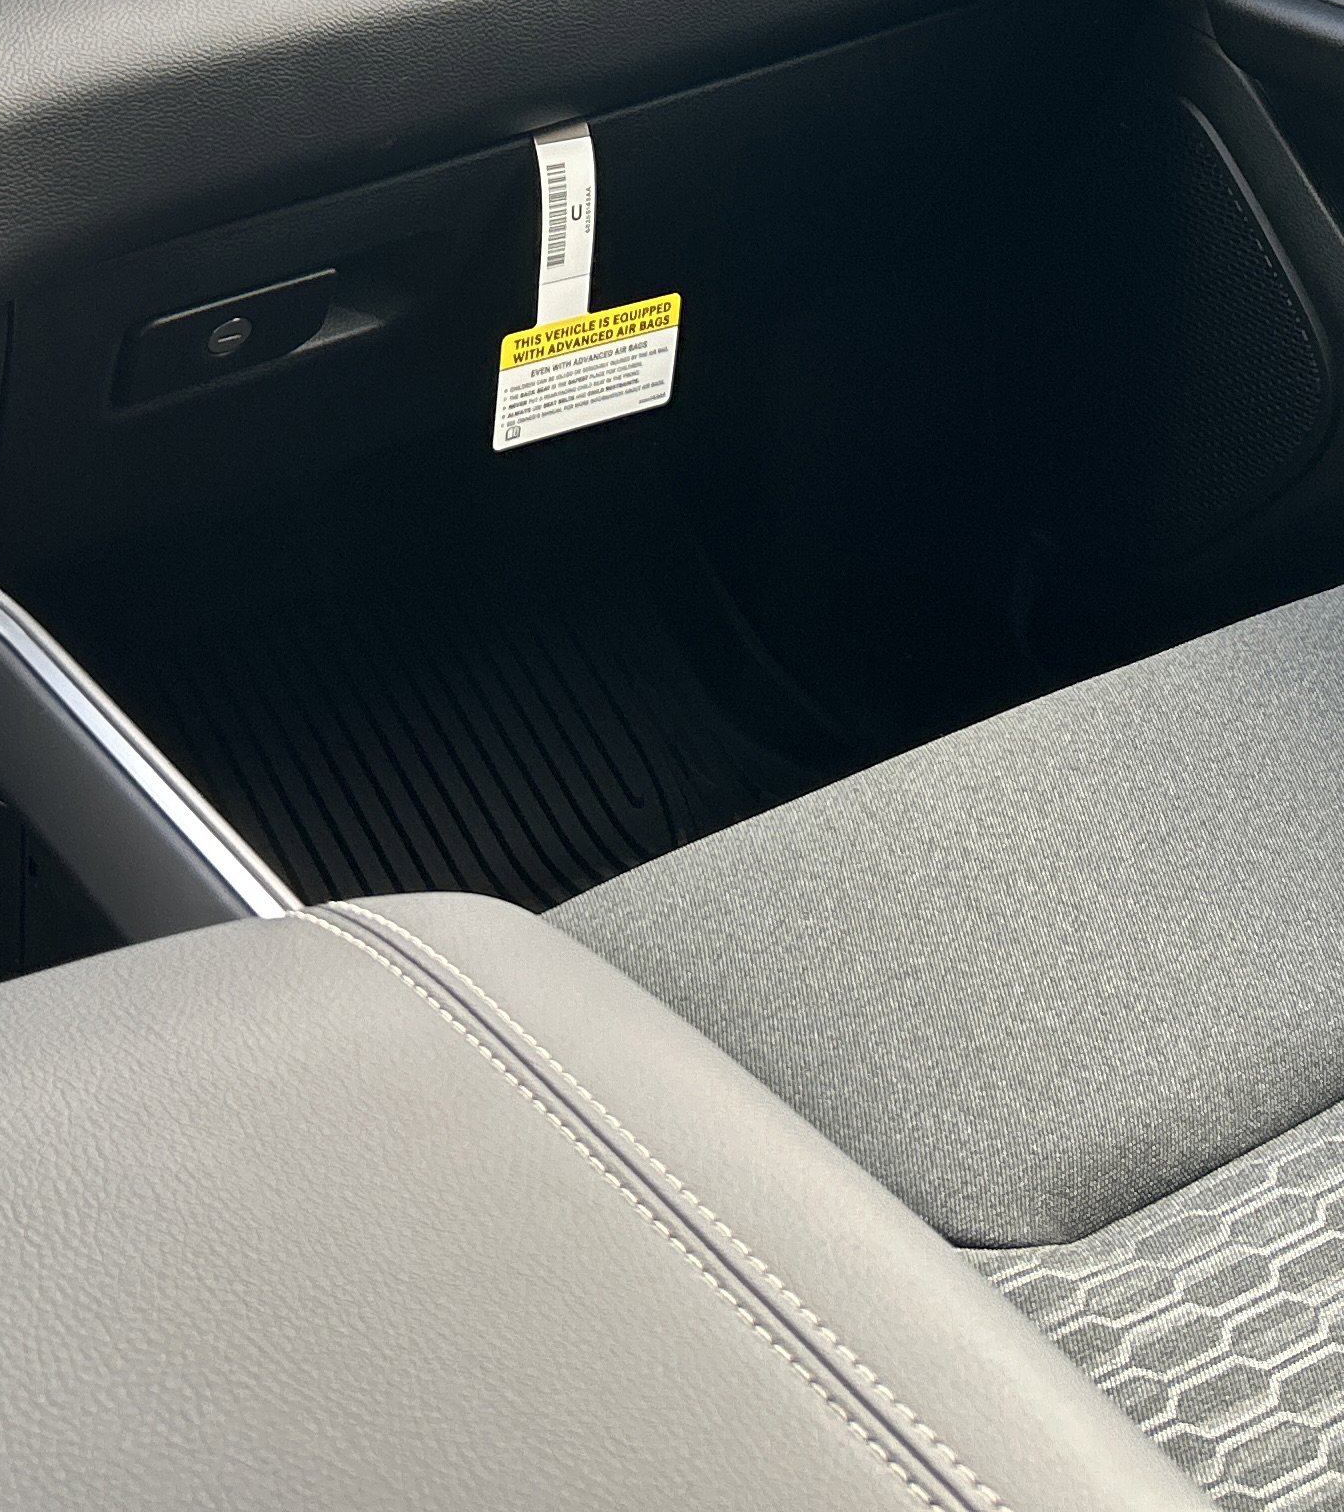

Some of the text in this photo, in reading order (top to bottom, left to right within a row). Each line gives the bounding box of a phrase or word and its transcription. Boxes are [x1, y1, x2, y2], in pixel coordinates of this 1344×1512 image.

[571, 204, 583, 221] U
[513, 315, 670, 364] WITH ADVANCED AIR BAGS
[515, 302, 671, 350] THIS VEHICLE IS EQUIPPED
